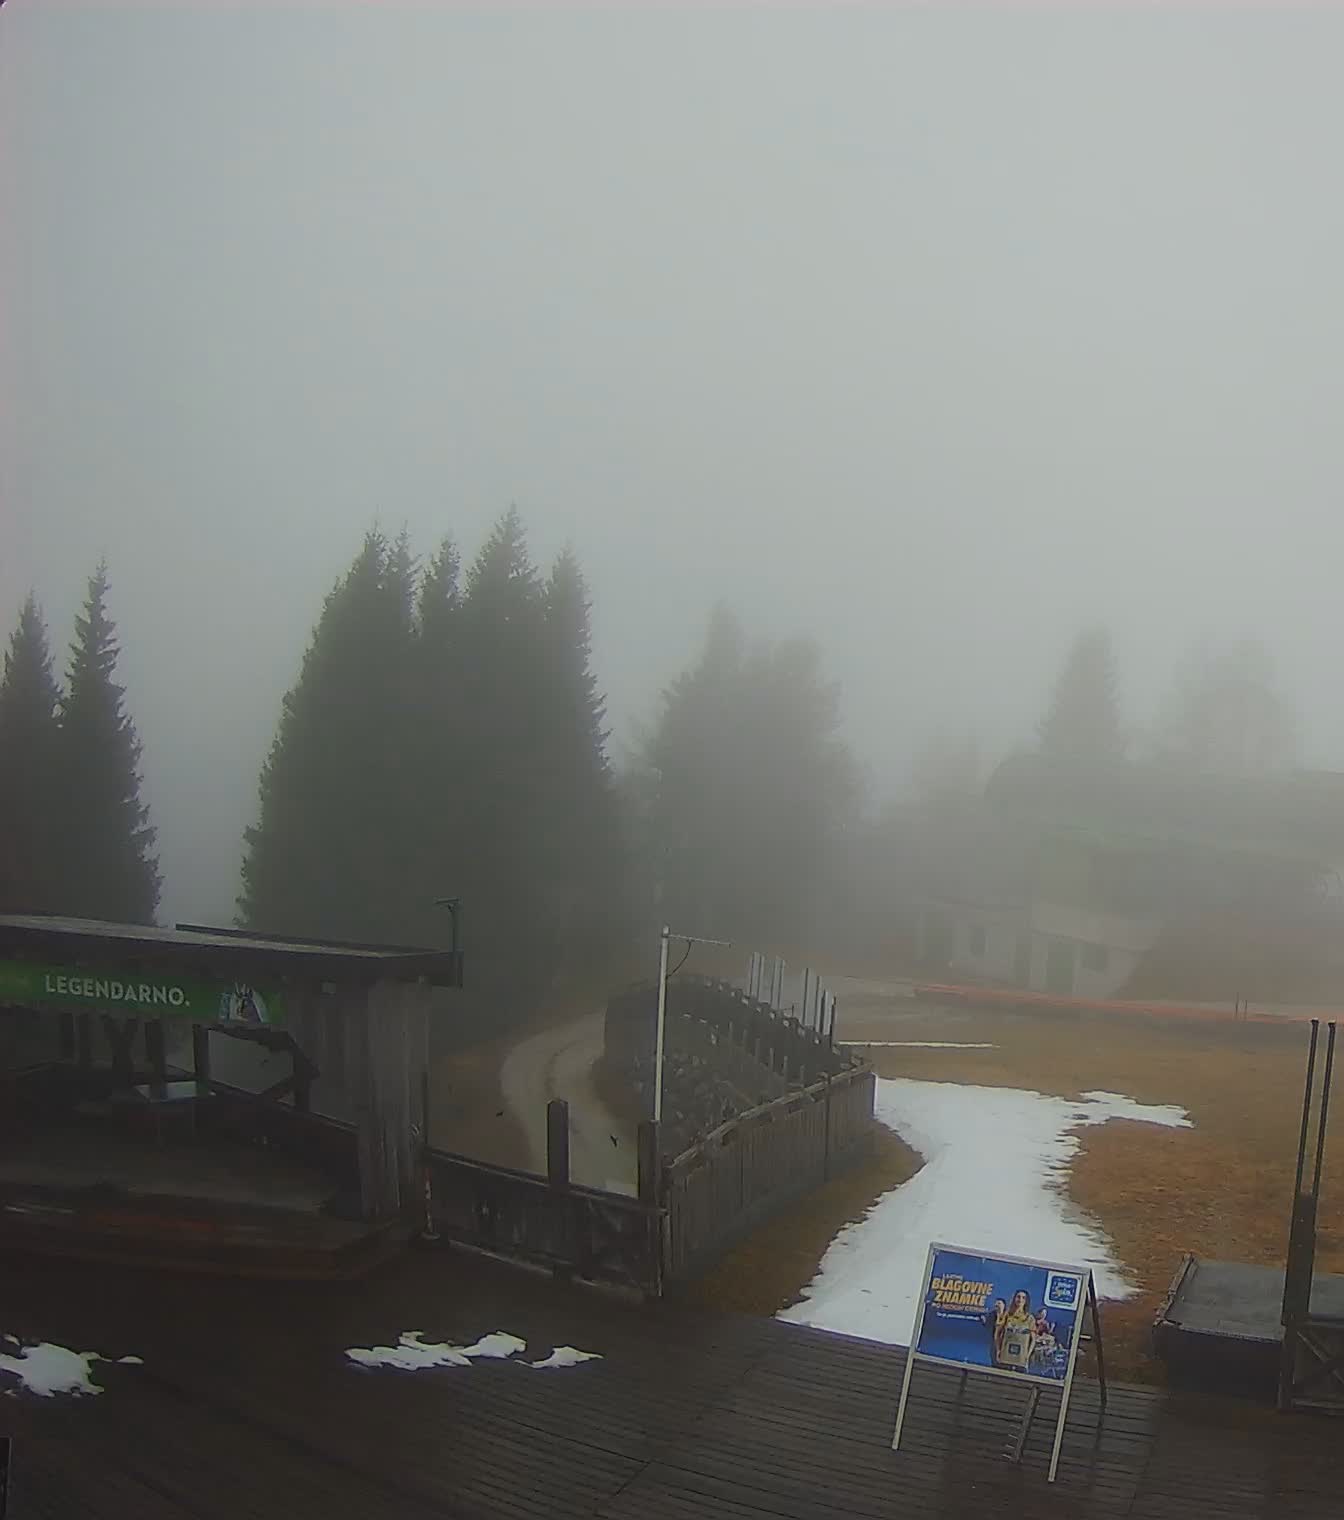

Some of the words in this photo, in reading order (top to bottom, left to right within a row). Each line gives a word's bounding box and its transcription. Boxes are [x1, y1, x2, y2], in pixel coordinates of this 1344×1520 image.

[44, 974, 190, 1007] LEGENDARNO.
[932, 1277, 993, 1295] BLAGOVNE
[934, 1290, 986, 1306] ZNAMKE
